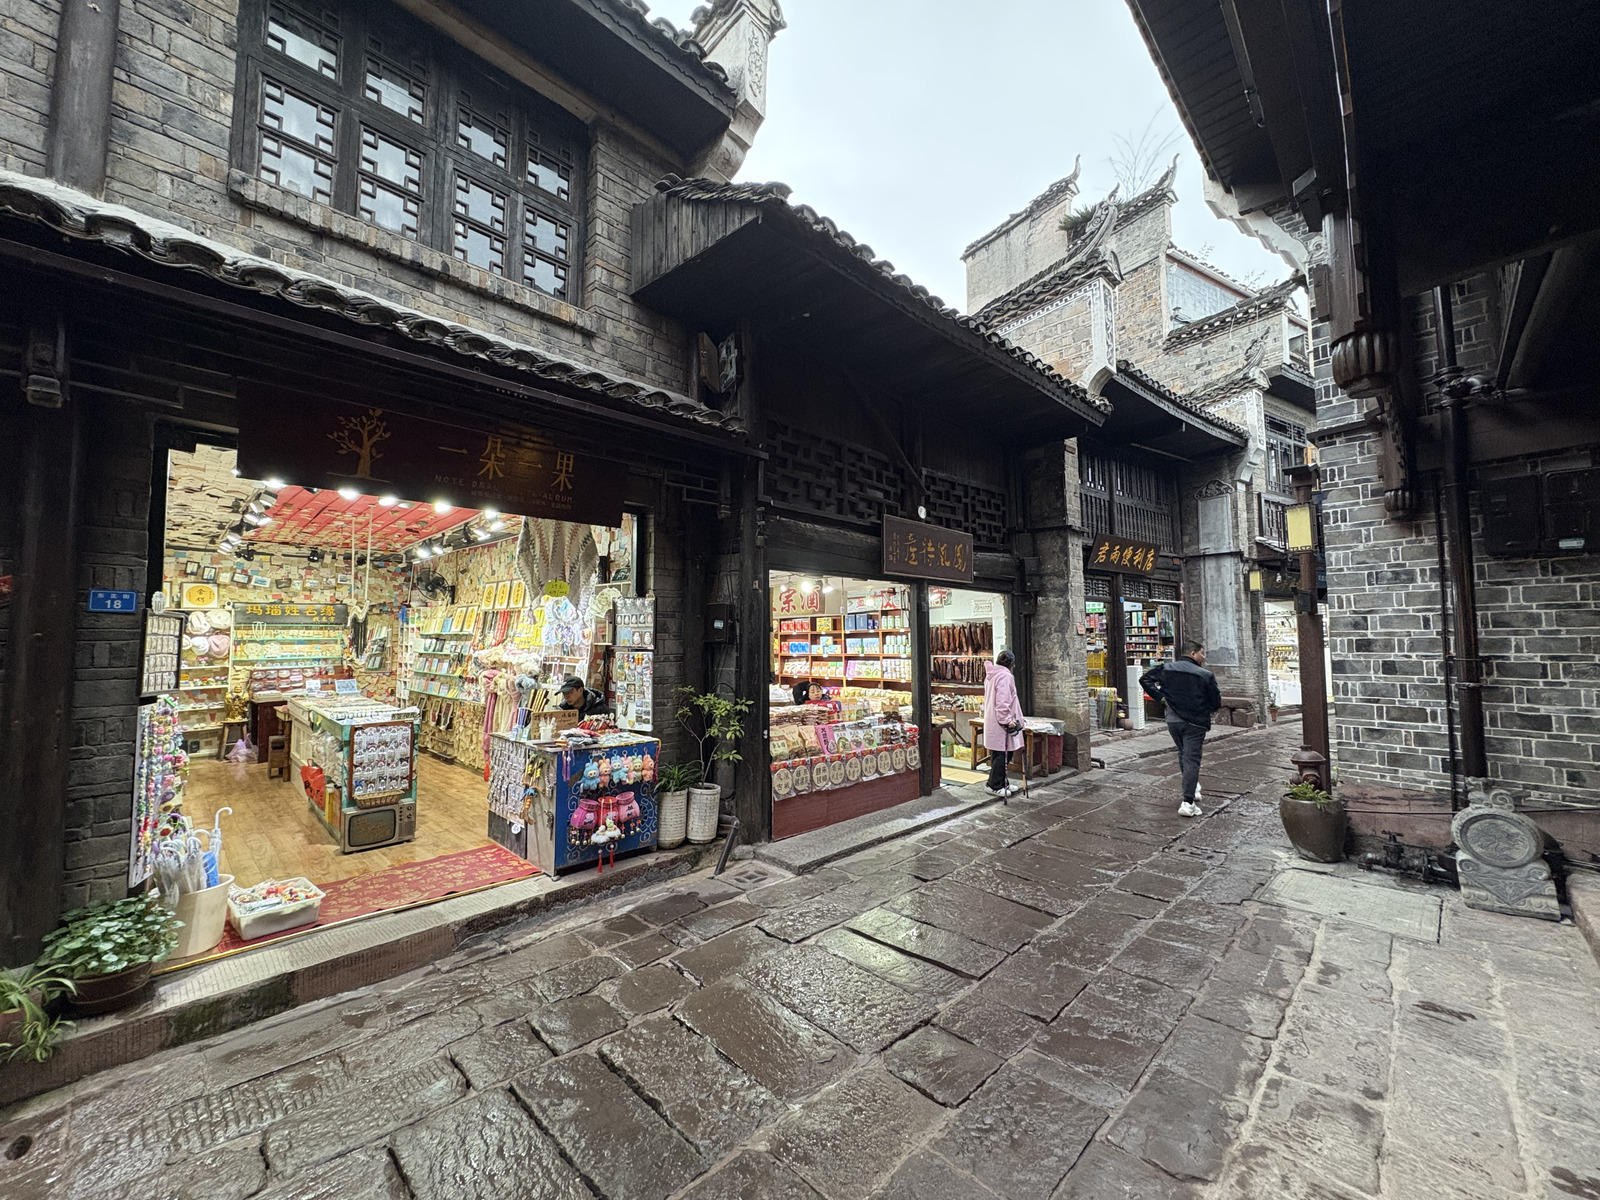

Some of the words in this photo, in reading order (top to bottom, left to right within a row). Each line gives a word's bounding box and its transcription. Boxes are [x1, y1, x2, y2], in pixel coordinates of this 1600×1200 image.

[438, 435, 575, 492] 一朵一果
[105, 599, 122, 609] 18
[772, 585, 821, 614] 宗酒
